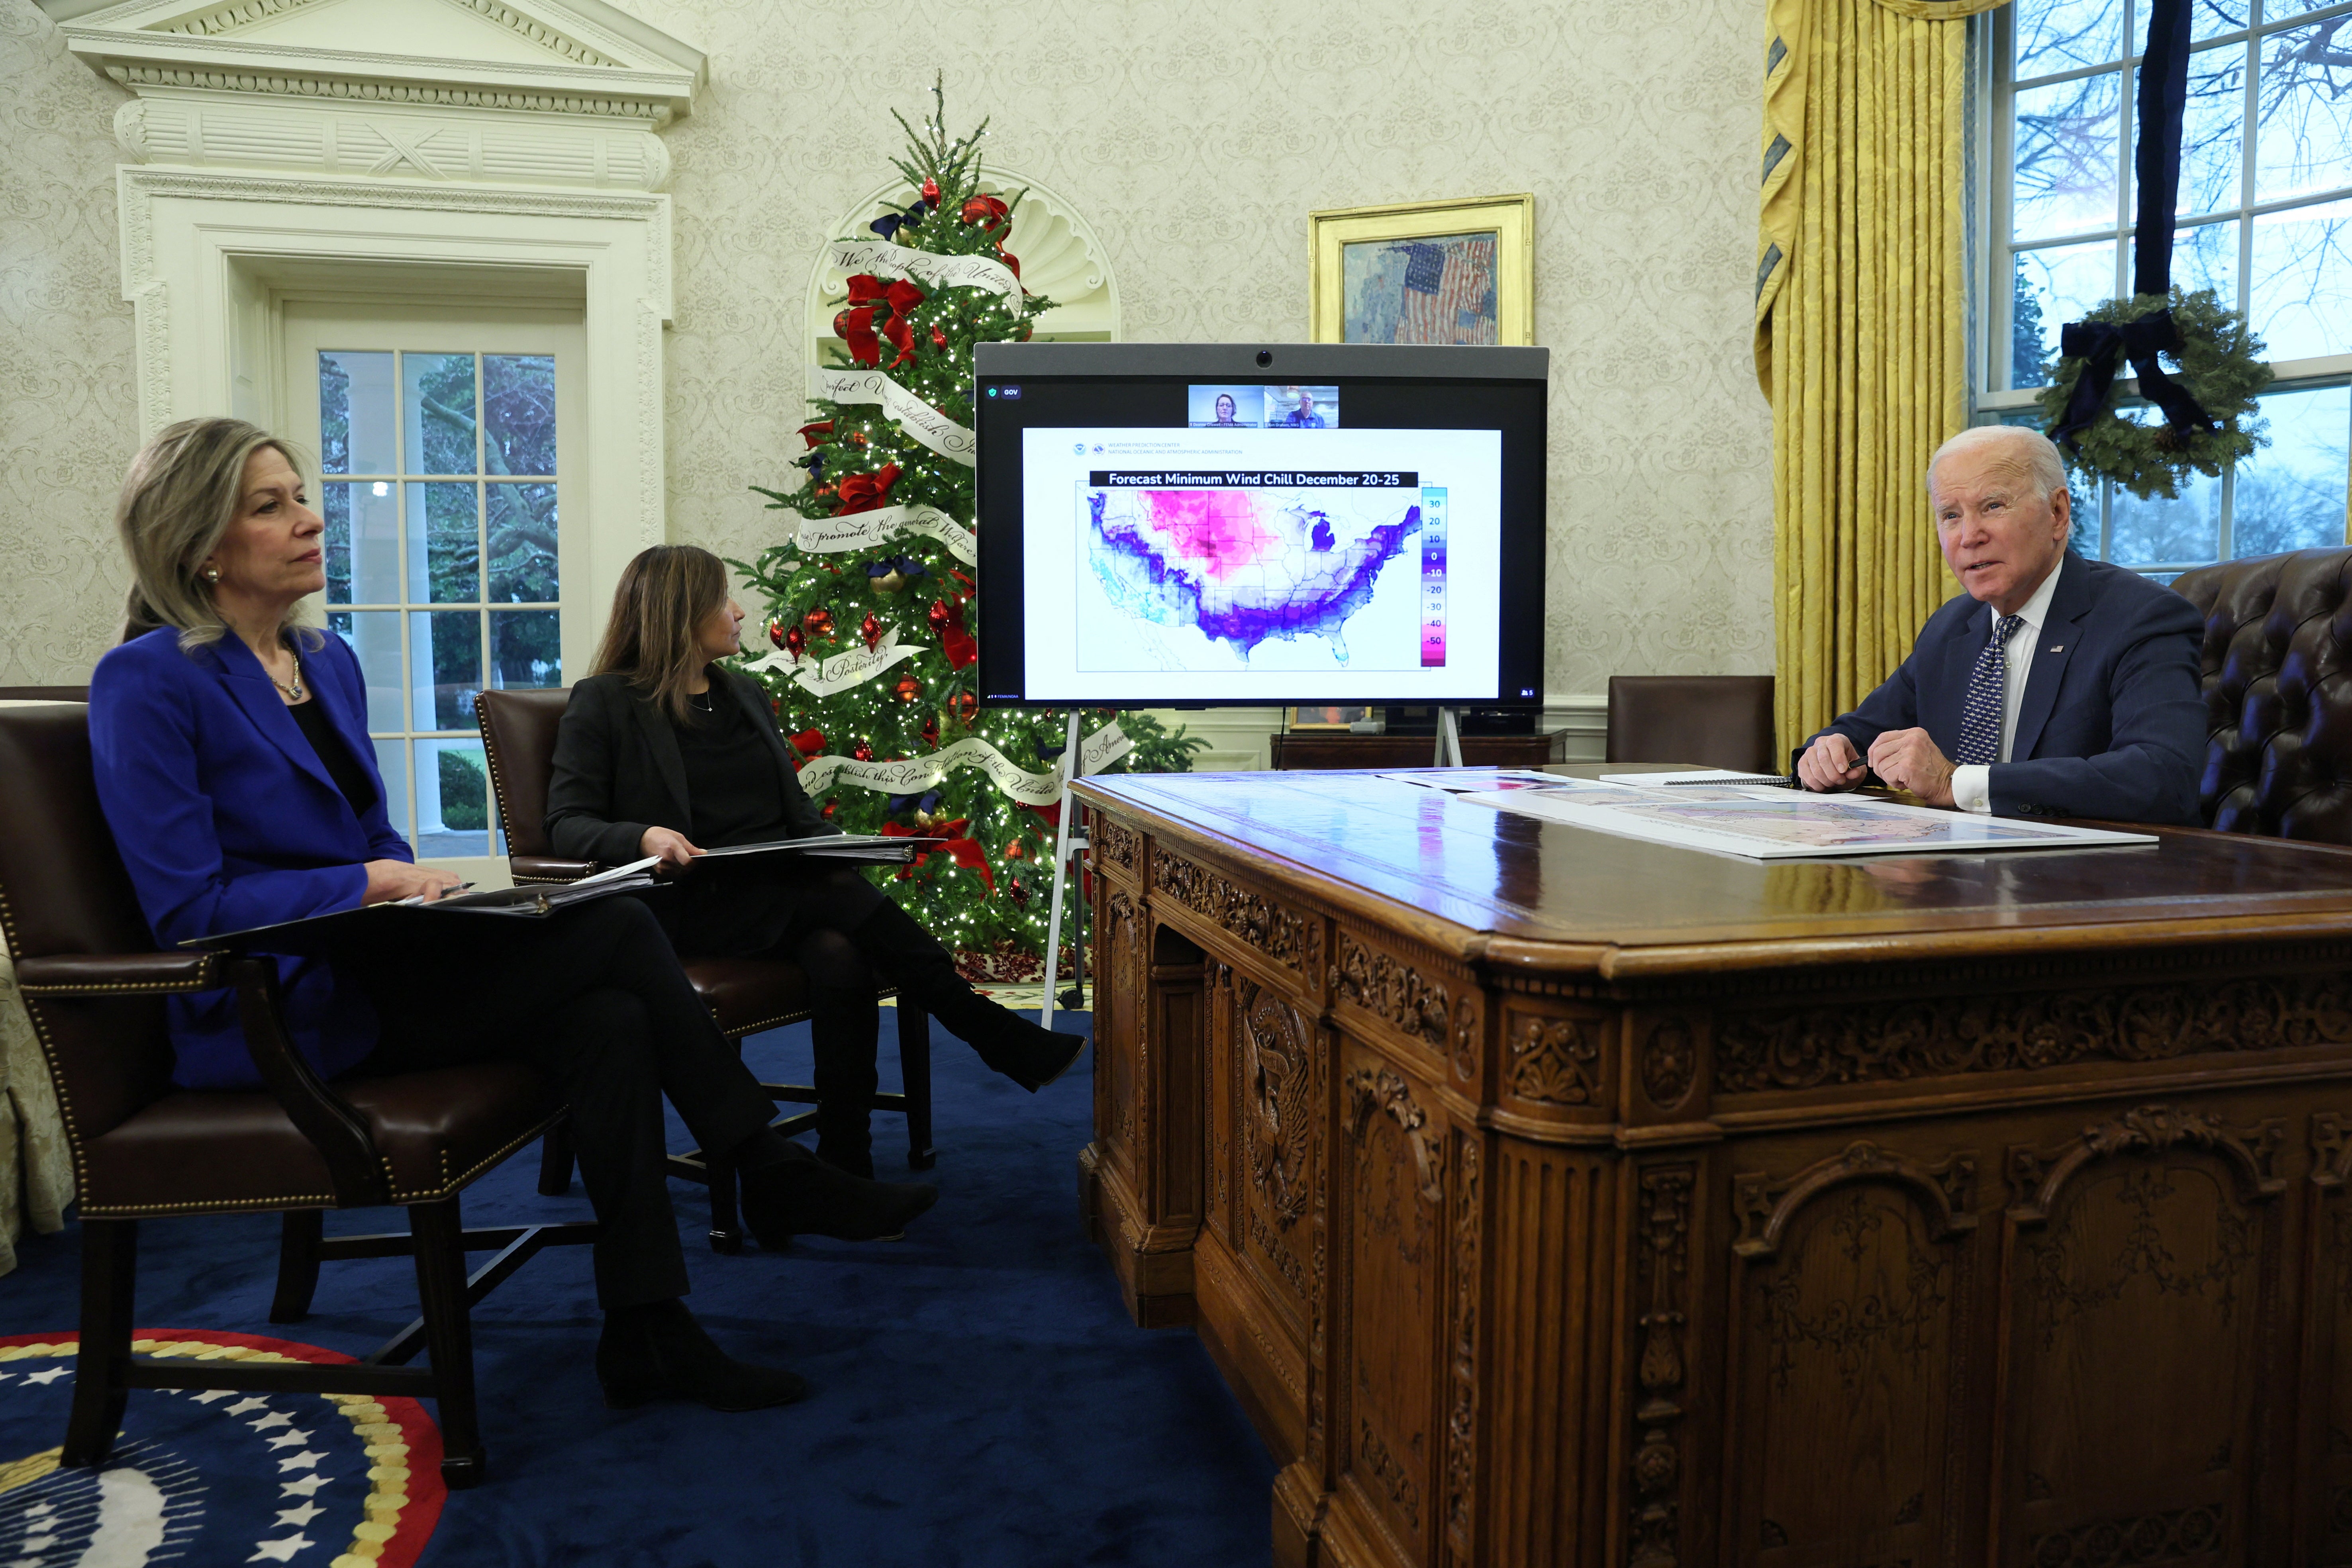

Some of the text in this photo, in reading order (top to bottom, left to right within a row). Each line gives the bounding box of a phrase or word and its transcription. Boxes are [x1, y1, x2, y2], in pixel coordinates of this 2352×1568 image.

[830, 246, 1011, 290] We the People of the United
[820, 375, 860, 398] perfect
[893, 400, 950, 437] establish
[1109, 473, 1399, 485] Forecast Minimum Wind Chill December 20-25
[804, 521, 871, 550] promote
[869, 515, 897, 541] the
[899, 517, 940, 530] general
[826, 645, 888, 682] Posterity,
[814, 764, 877, 790] esblish
[874, 769, 896, 785] this
[891, 749, 977, 786] Constitution
[968, 751, 995, 764] of
[990, 757, 1006, 777] the
[1005, 773, 1055, 794] United
[1081, 749, 1090, 774] f
